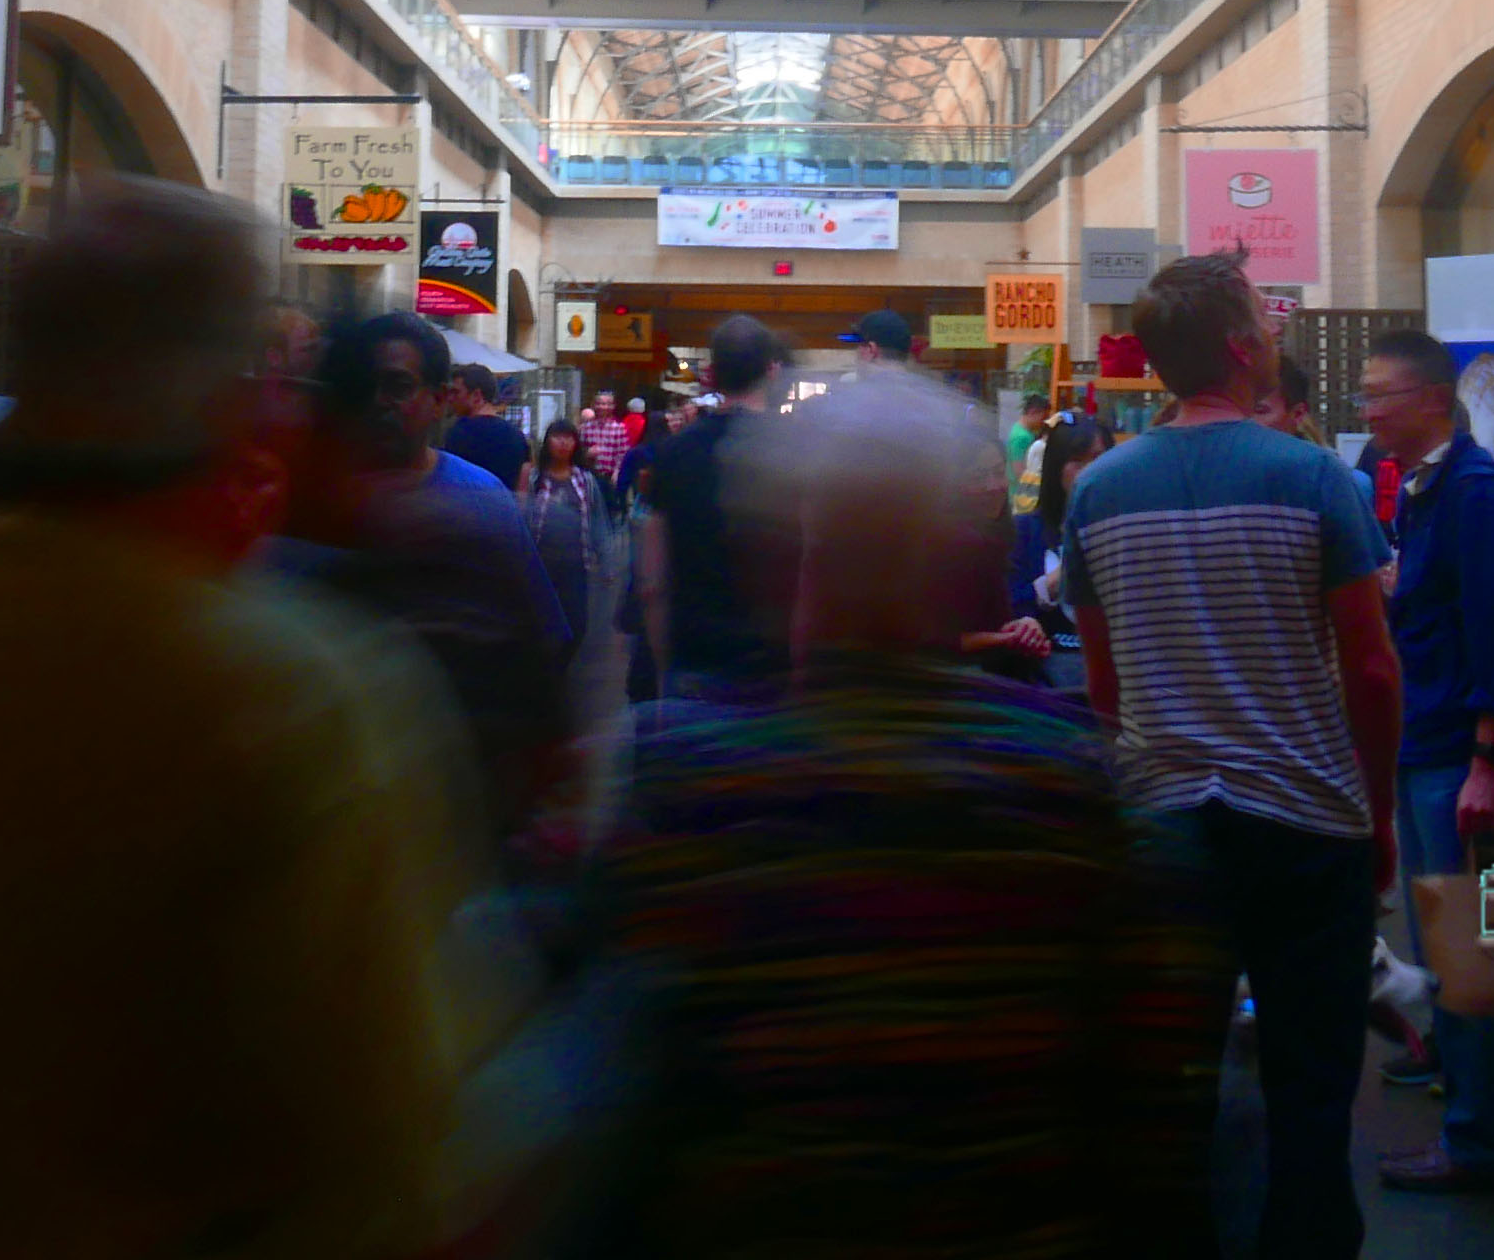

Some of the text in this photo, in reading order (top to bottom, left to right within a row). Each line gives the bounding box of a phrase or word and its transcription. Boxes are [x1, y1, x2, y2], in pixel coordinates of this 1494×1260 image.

[293, 132, 414, 156] Farm Fresh
[311, 158, 394, 180] To You
[749, 208, 801, 220] SUMMER
[736, 221, 816, 235] CELEBRATION
[1209, 213, 1297, 241] miette
[1090, 255, 1146, 268] HEATH
[995, 282, 1056, 302] RANCHO
[994, 303, 1056, 329] GORDO
